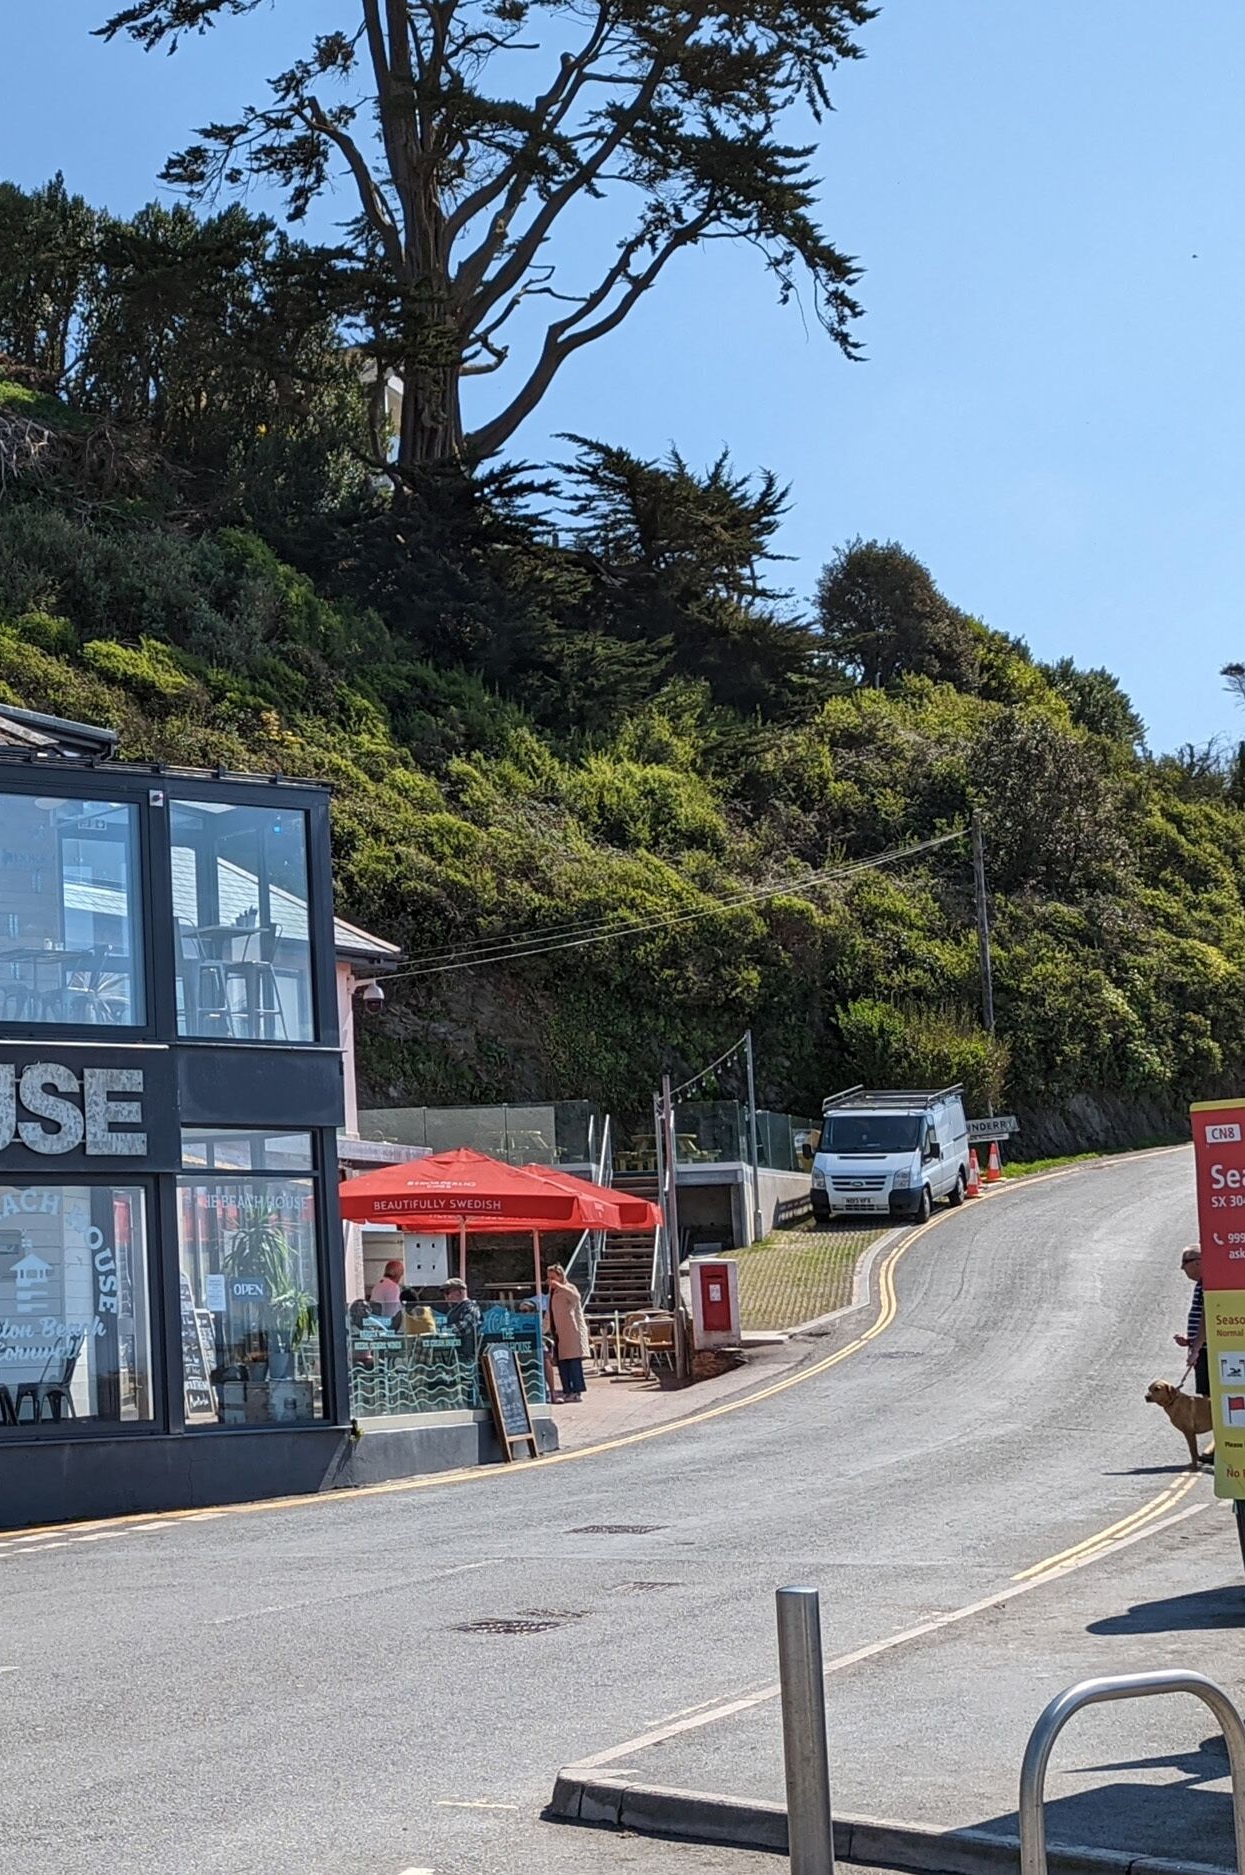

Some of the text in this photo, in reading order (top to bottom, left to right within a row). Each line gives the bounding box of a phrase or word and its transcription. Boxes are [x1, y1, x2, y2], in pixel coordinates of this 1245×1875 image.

[1211, 1127, 1235, 1140] CN8
[1210, 1163, 1245, 1190] Se
[266, 1194, 309, 1210] HOUSE
[373, 1199, 502, 1211] BEAUTIFULLY SWEDISH
[1211, 1196, 1227, 1208] SX
[65, 1202, 118, 1314] HOUSE
[233, 1282, 265, 1296] OPEN
[39, 1314, 107, 1338] Beach
[1216, 1327, 1244, 1338] Normal
[1226, 1468, 1240, 1478] No
